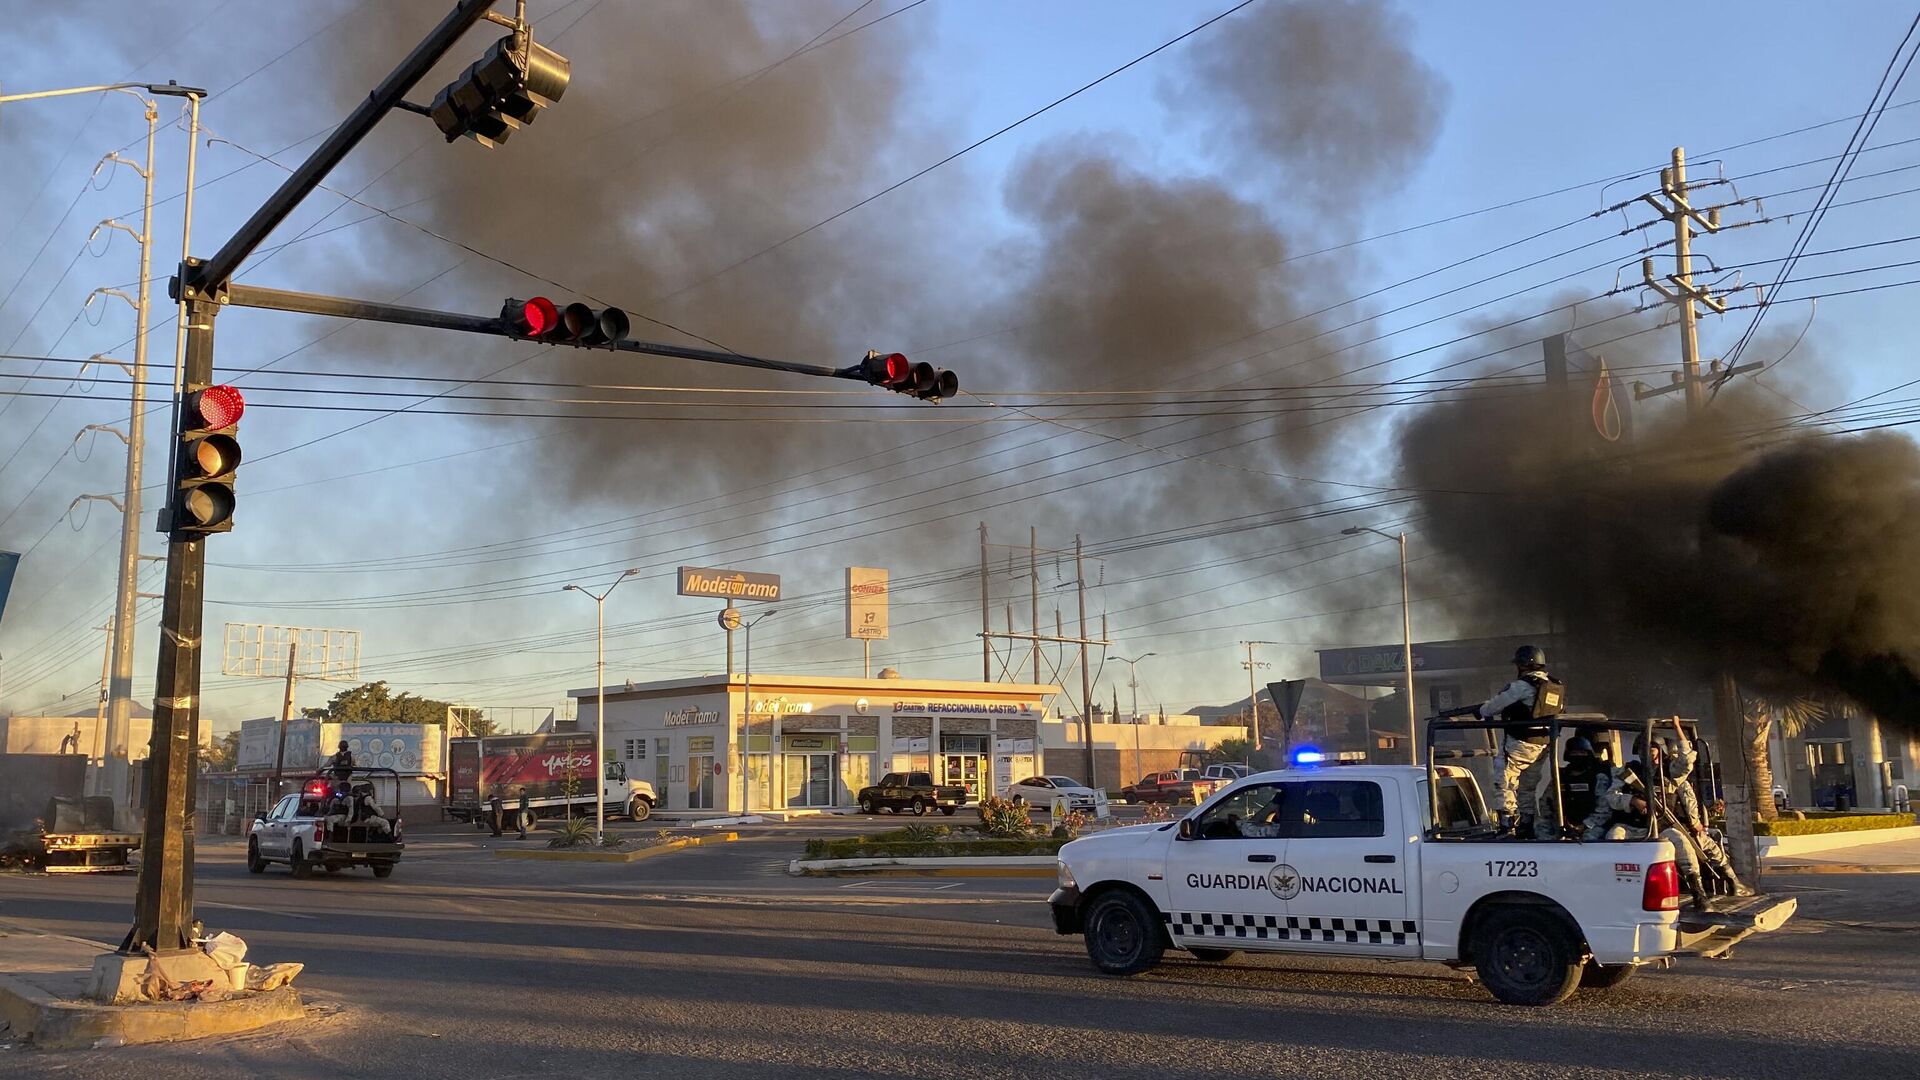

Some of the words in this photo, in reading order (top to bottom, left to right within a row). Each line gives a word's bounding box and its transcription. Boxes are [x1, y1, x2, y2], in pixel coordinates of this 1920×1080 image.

[858, 627, 882, 635] CASTRO
[927, 703, 987, 714] REFACCIONARIA
[988, 704, 1018, 714] CASTRO
[1485, 860, 1538, 877] 17223
[1186, 873, 1269, 891] GUARDIA
[1302, 876, 1404, 894] NACIONAL
